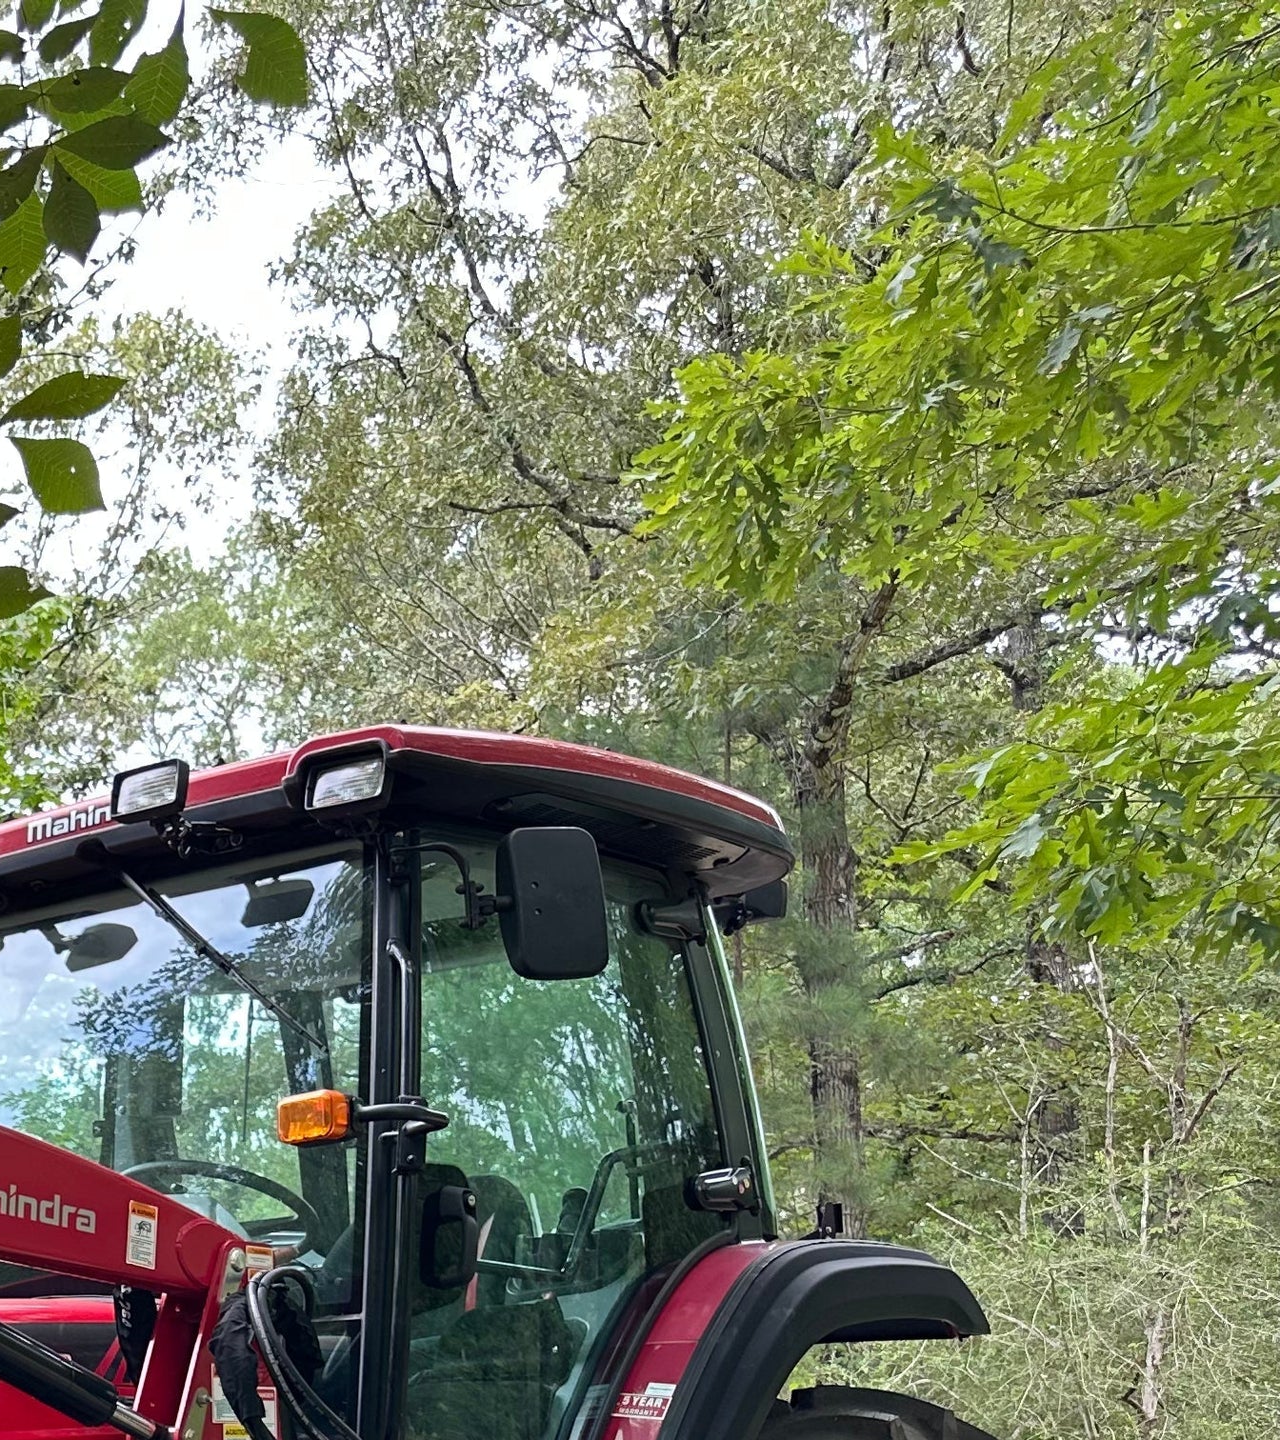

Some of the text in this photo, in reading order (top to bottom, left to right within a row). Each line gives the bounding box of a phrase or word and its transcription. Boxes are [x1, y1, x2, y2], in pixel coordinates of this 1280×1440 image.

[27, 805, 112, 843] Mahin
[621, 1395, 664, 1408] 5 YEAR
